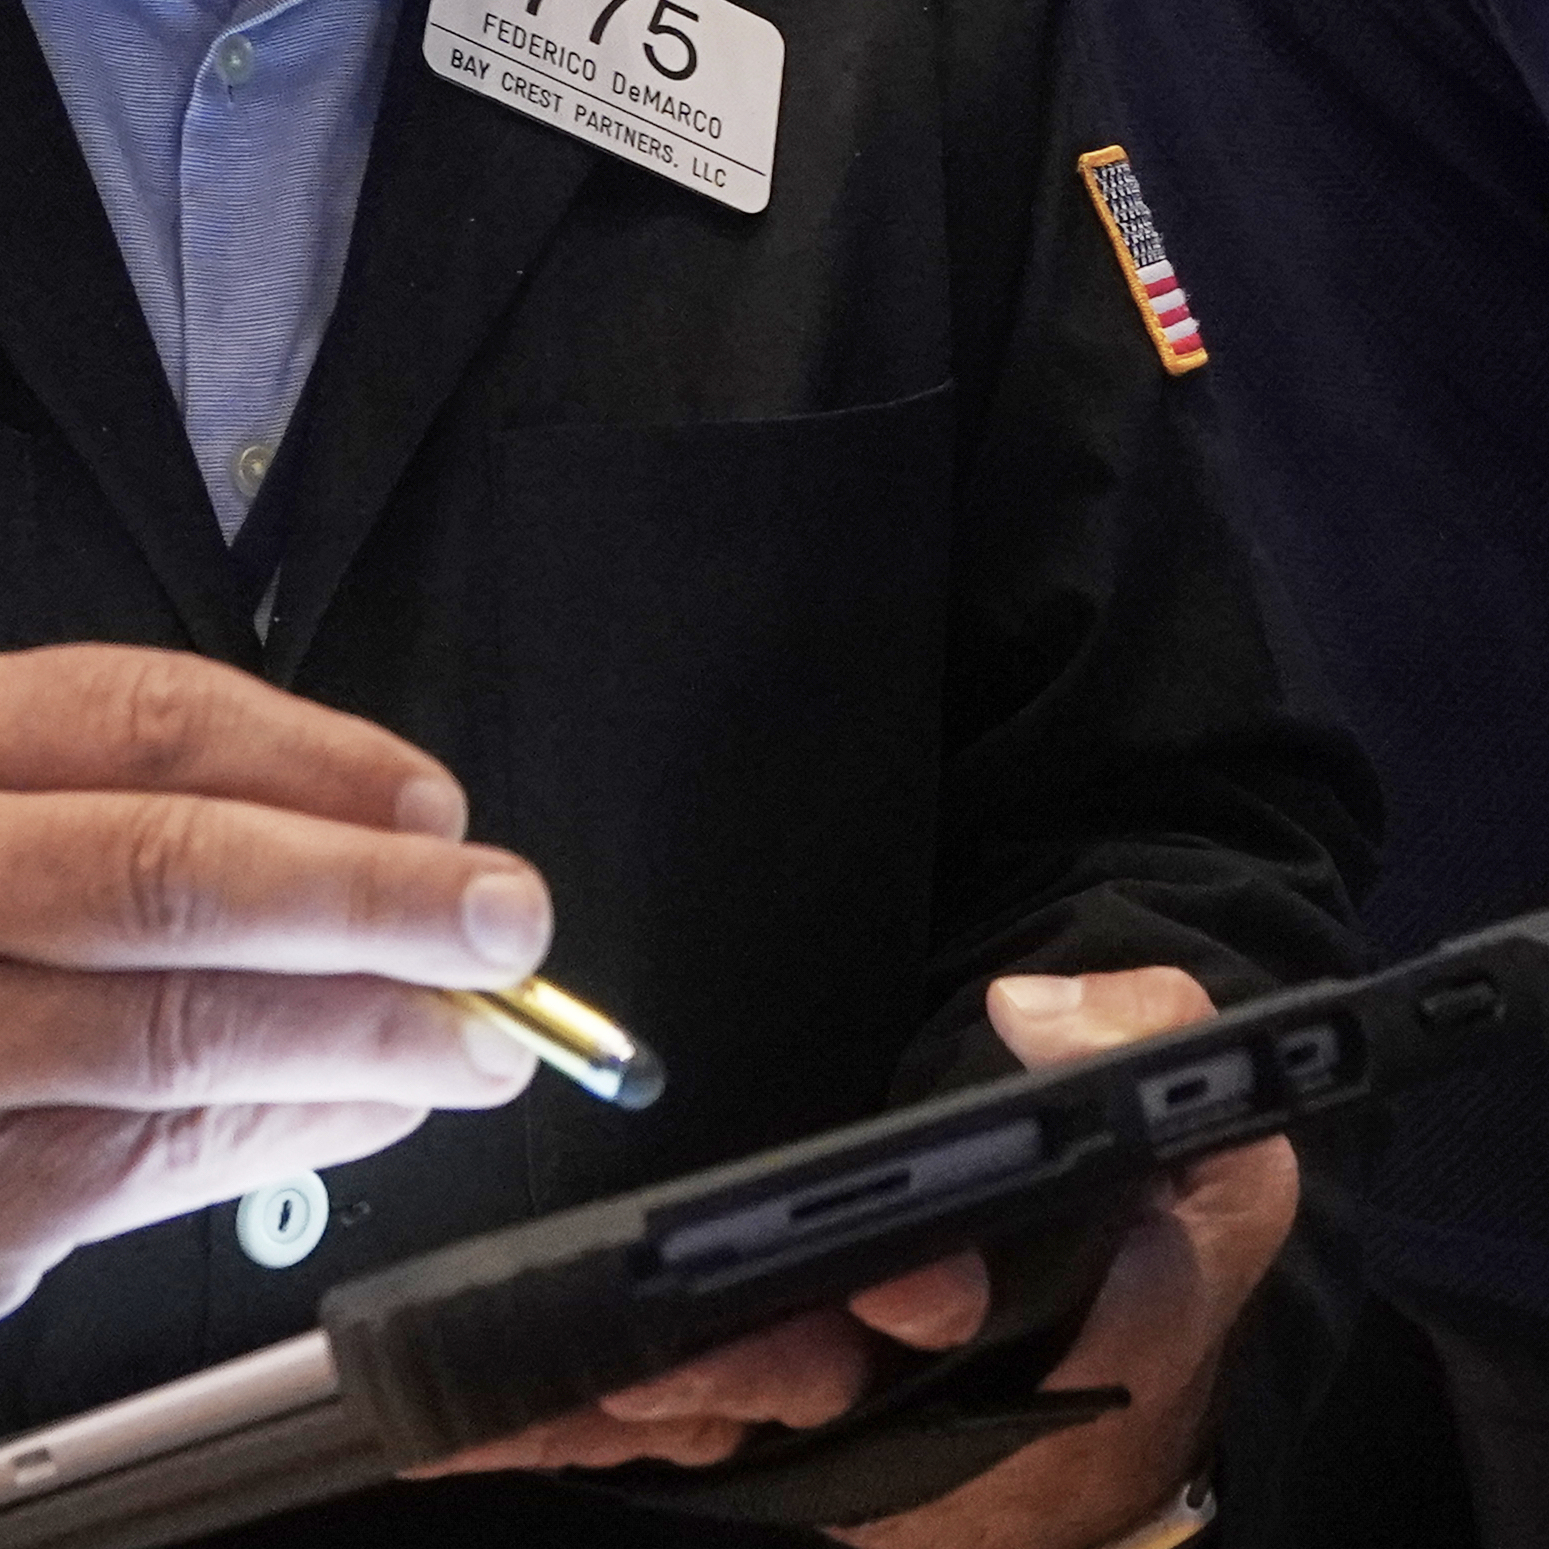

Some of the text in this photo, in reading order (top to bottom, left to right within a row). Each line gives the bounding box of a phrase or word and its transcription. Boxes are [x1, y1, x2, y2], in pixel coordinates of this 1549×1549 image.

[450, 48, 490, 81] BAY
[501, 71, 564, 114] CREST
[692, 156, 728, 189] LLC
[482, 12, 723, 141] FEDERICO DeMARCO
